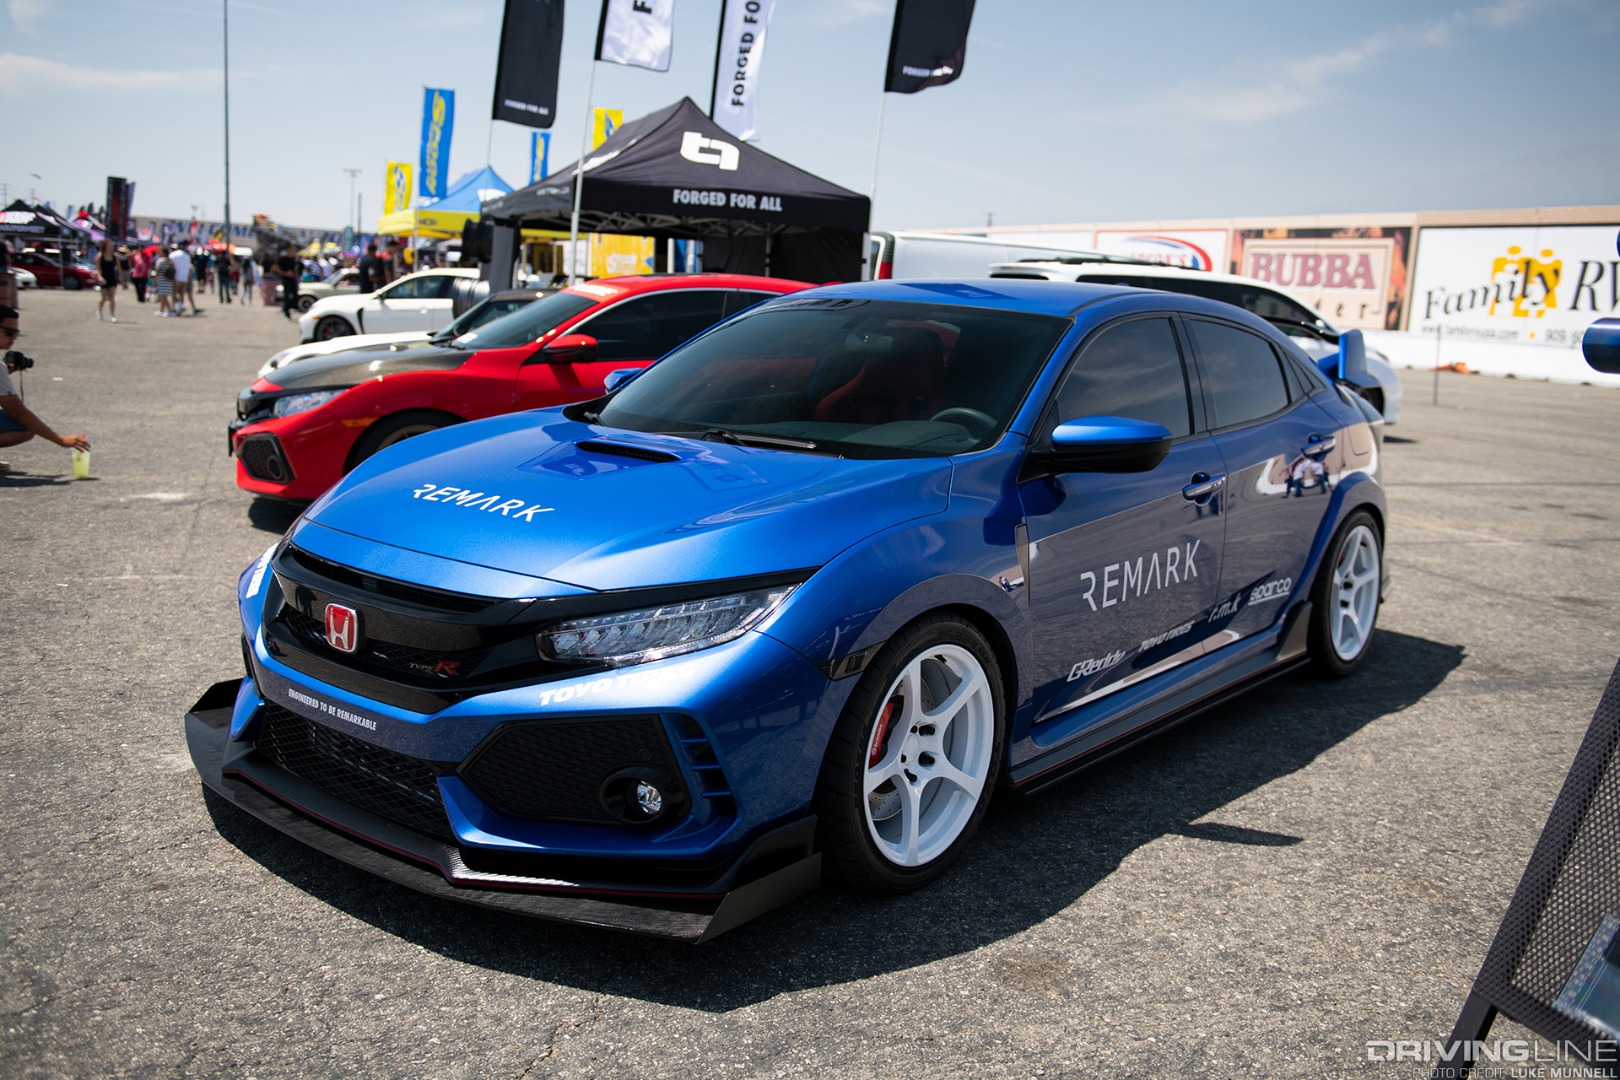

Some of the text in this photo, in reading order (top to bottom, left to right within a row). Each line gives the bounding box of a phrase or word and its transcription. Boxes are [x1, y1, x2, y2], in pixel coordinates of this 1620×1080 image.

[731, 32, 755, 107] FORGED
[673, 189, 783, 211] FORGED FOR ALL
[1252, 253, 1375, 289] BUBBA
[1424, 260, 1560, 320] Family
[413, 483, 556, 523] REMARK
[1080, 540, 1200, 611] REMARK
[1250, 577, 1292, 604] sparco
[434, 660, 460, 677] R
[288, 688, 377, 731] ENGINEERED TO BE REMARKABLE
[539, 678, 612, 706] TOYO
